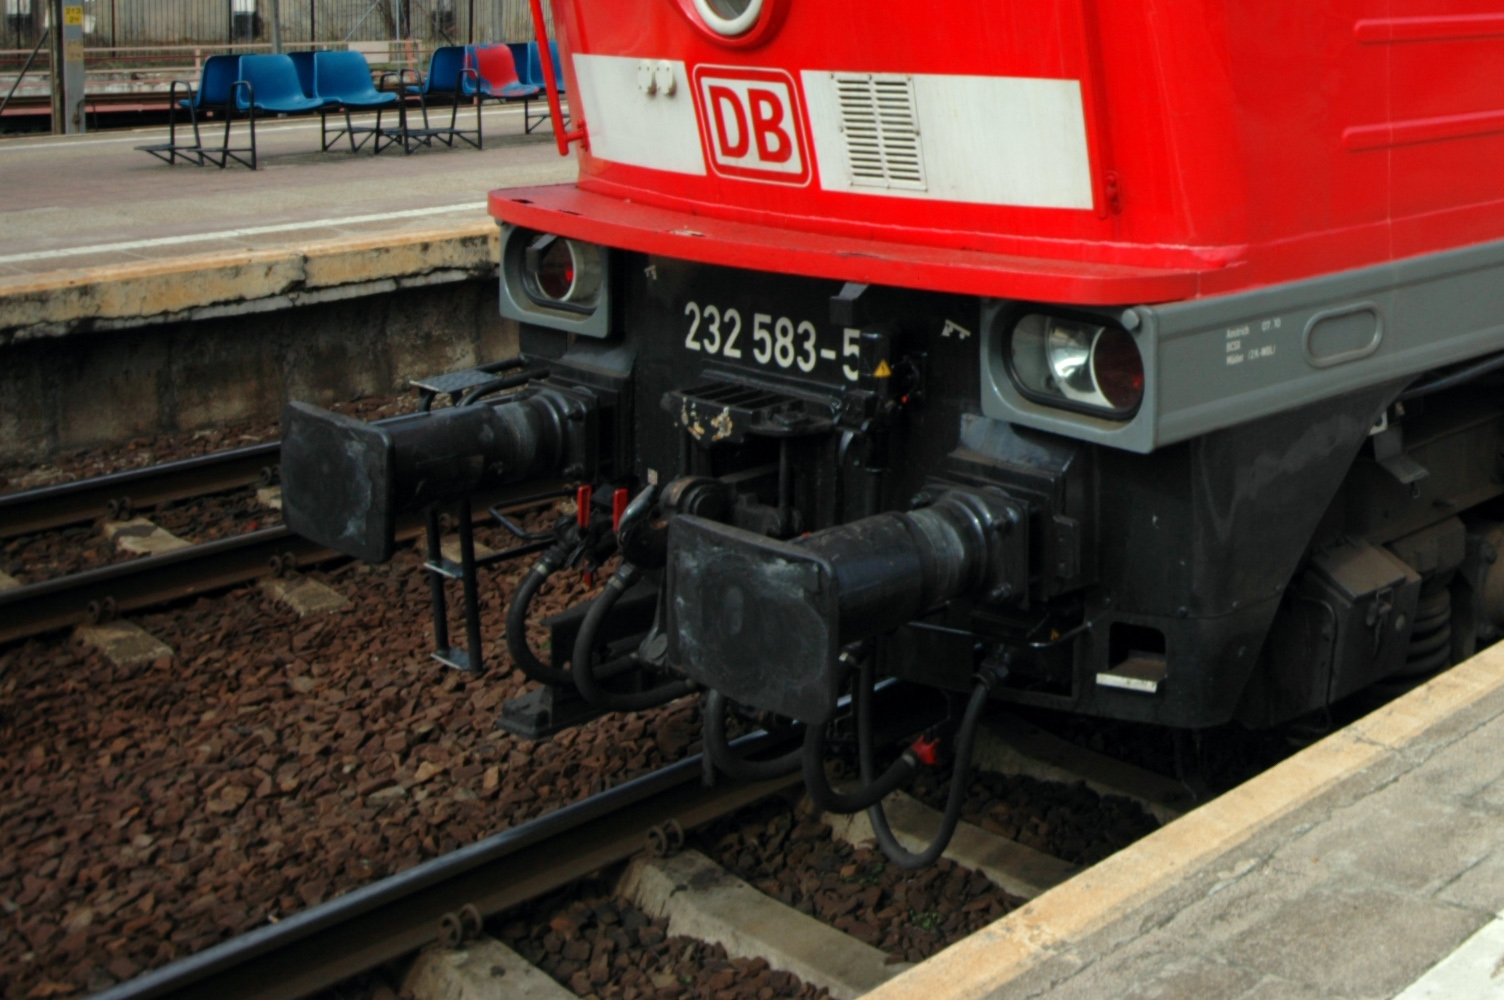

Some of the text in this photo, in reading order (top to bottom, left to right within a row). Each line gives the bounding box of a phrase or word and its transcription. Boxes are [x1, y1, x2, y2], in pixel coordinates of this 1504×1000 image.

[708, 85, 792, 164] DB
[684, 301, 861, 381] 232 583-5
